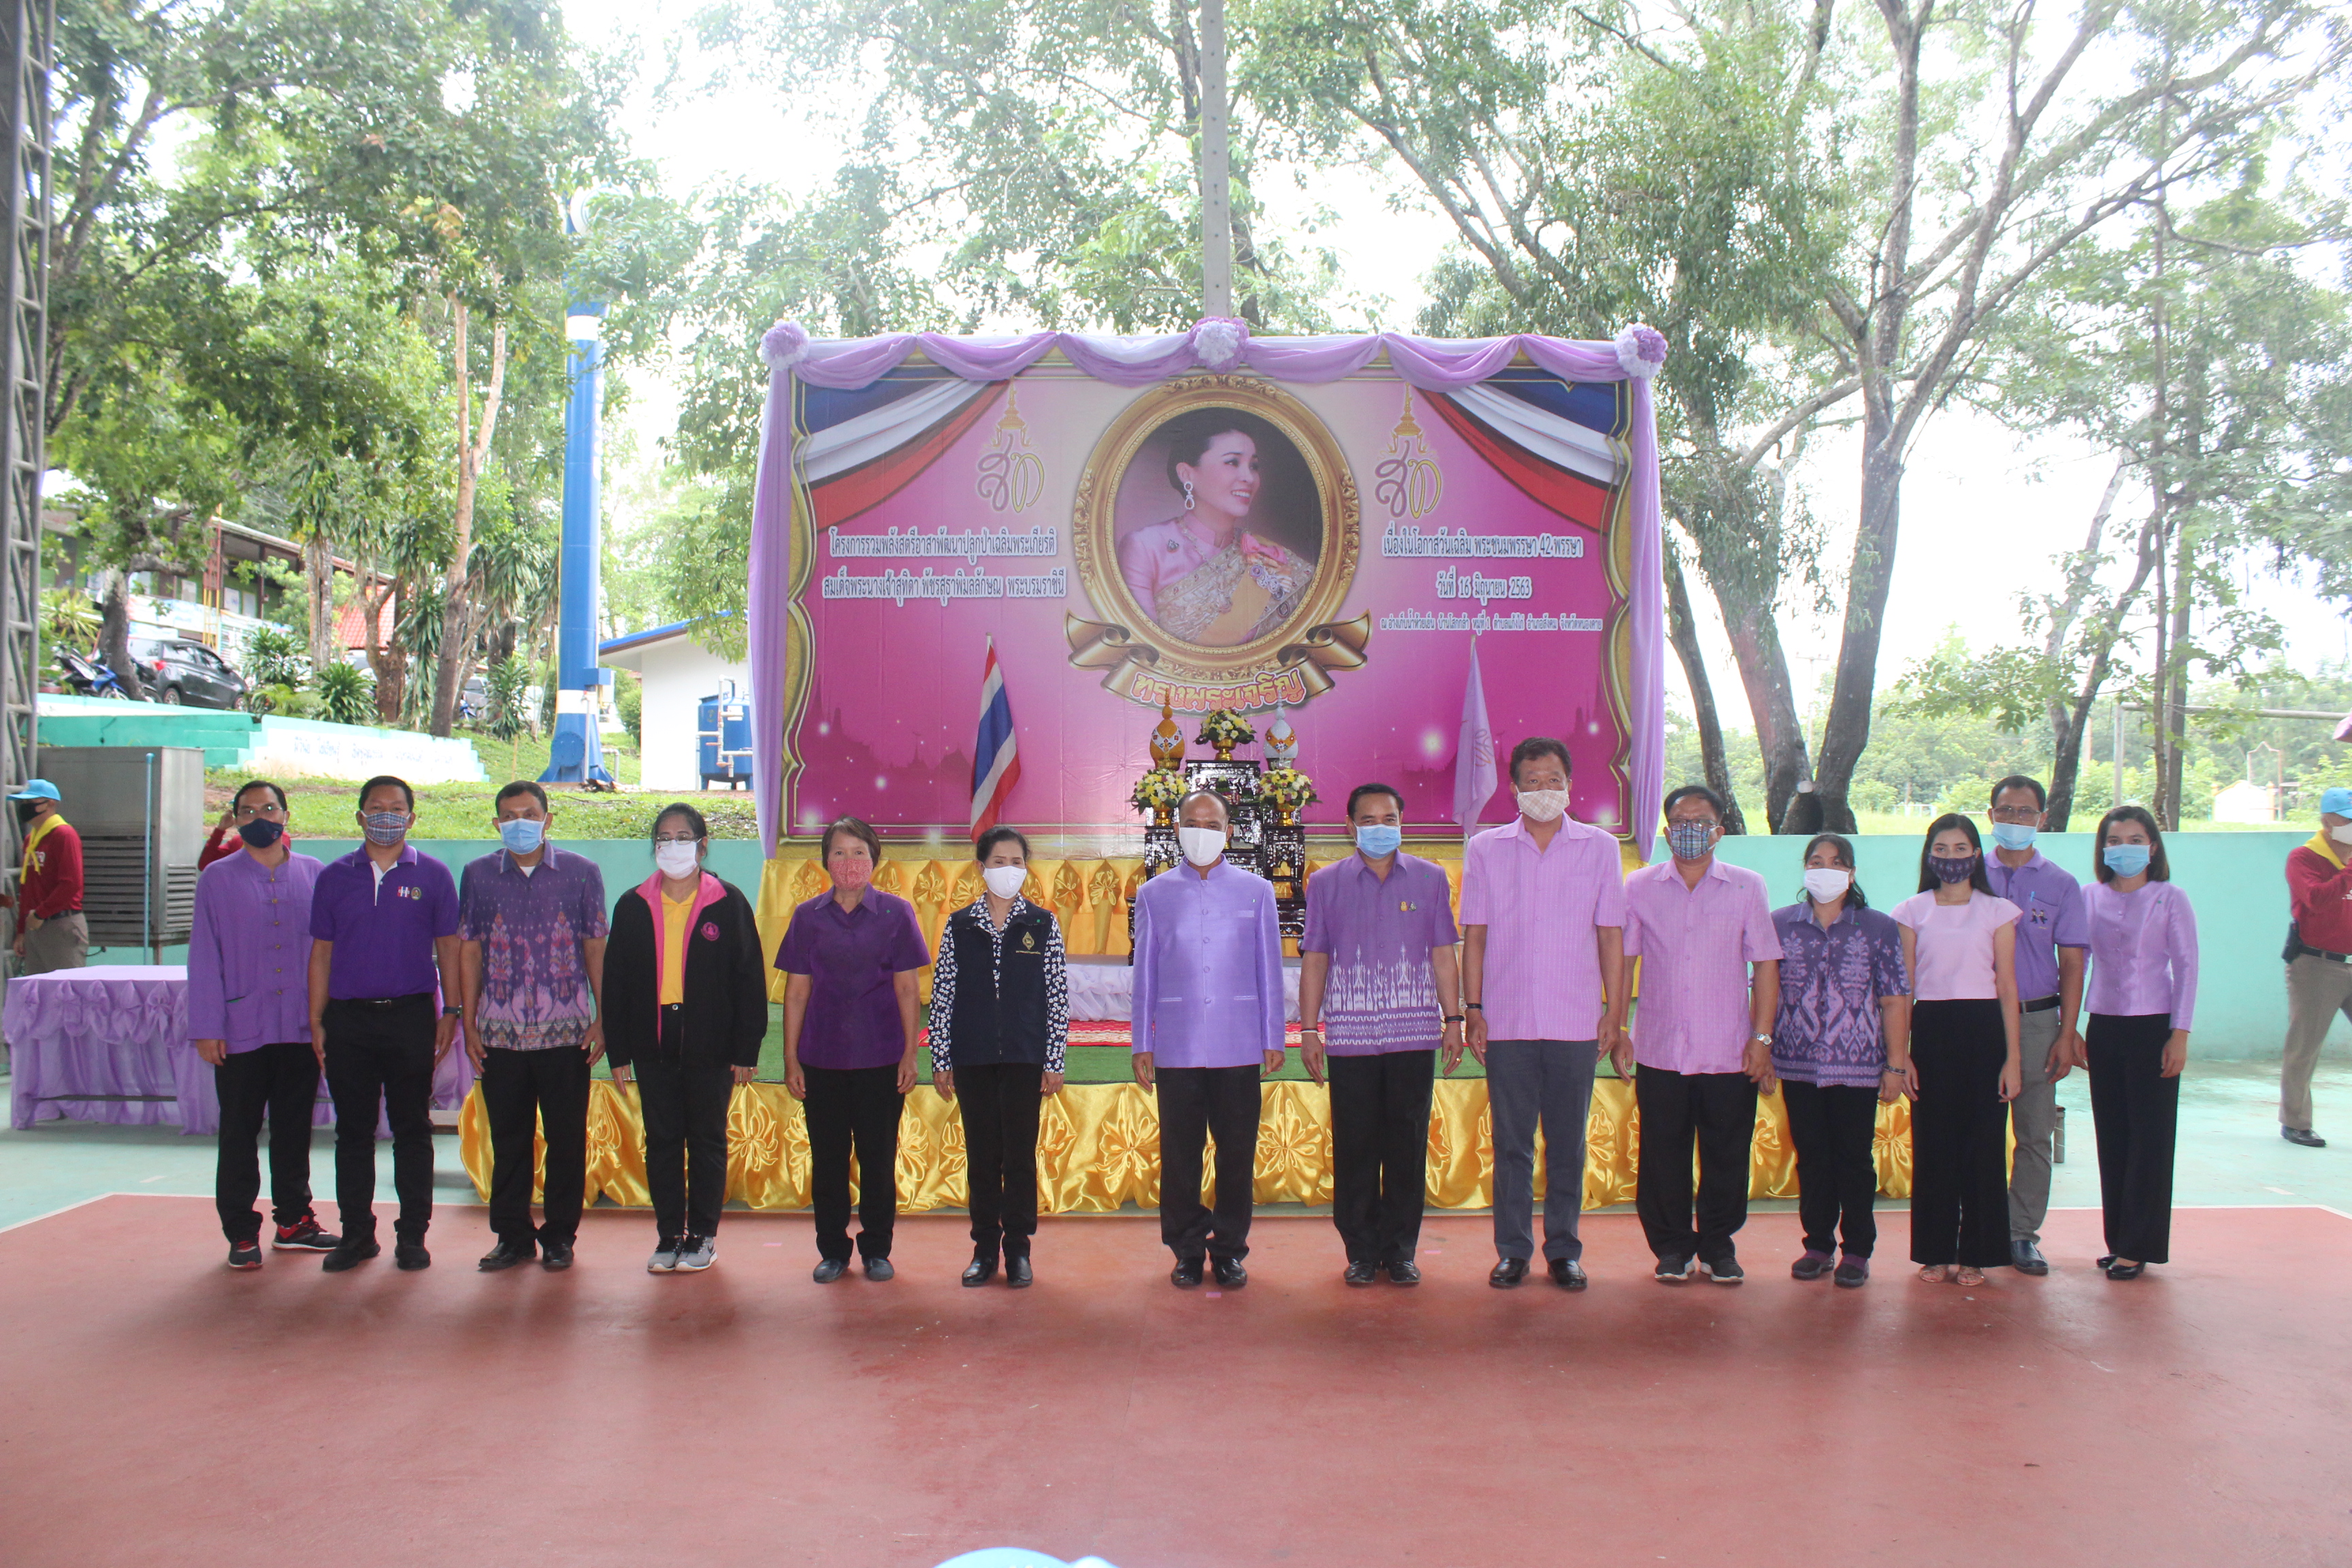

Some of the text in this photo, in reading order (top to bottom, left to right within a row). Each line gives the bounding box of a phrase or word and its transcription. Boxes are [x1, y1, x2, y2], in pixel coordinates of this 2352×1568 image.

[830, 527, 1056, 564] โครงการรวมพลังสตรีอาสาพัฒนาปลูกป่าเฉลิมพระเกียรติ
[1539, 535, 1552, 555] 42
[1553, 538, 1582, 556] พรรษา
[1007, 567, 1065, 596] พระบรมราชินี
[1437, 567, 1531, 604] วันที่ 16 มิถุนายน 2563
[1130, 668, 1307, 713] ทรงพระเจริญ
